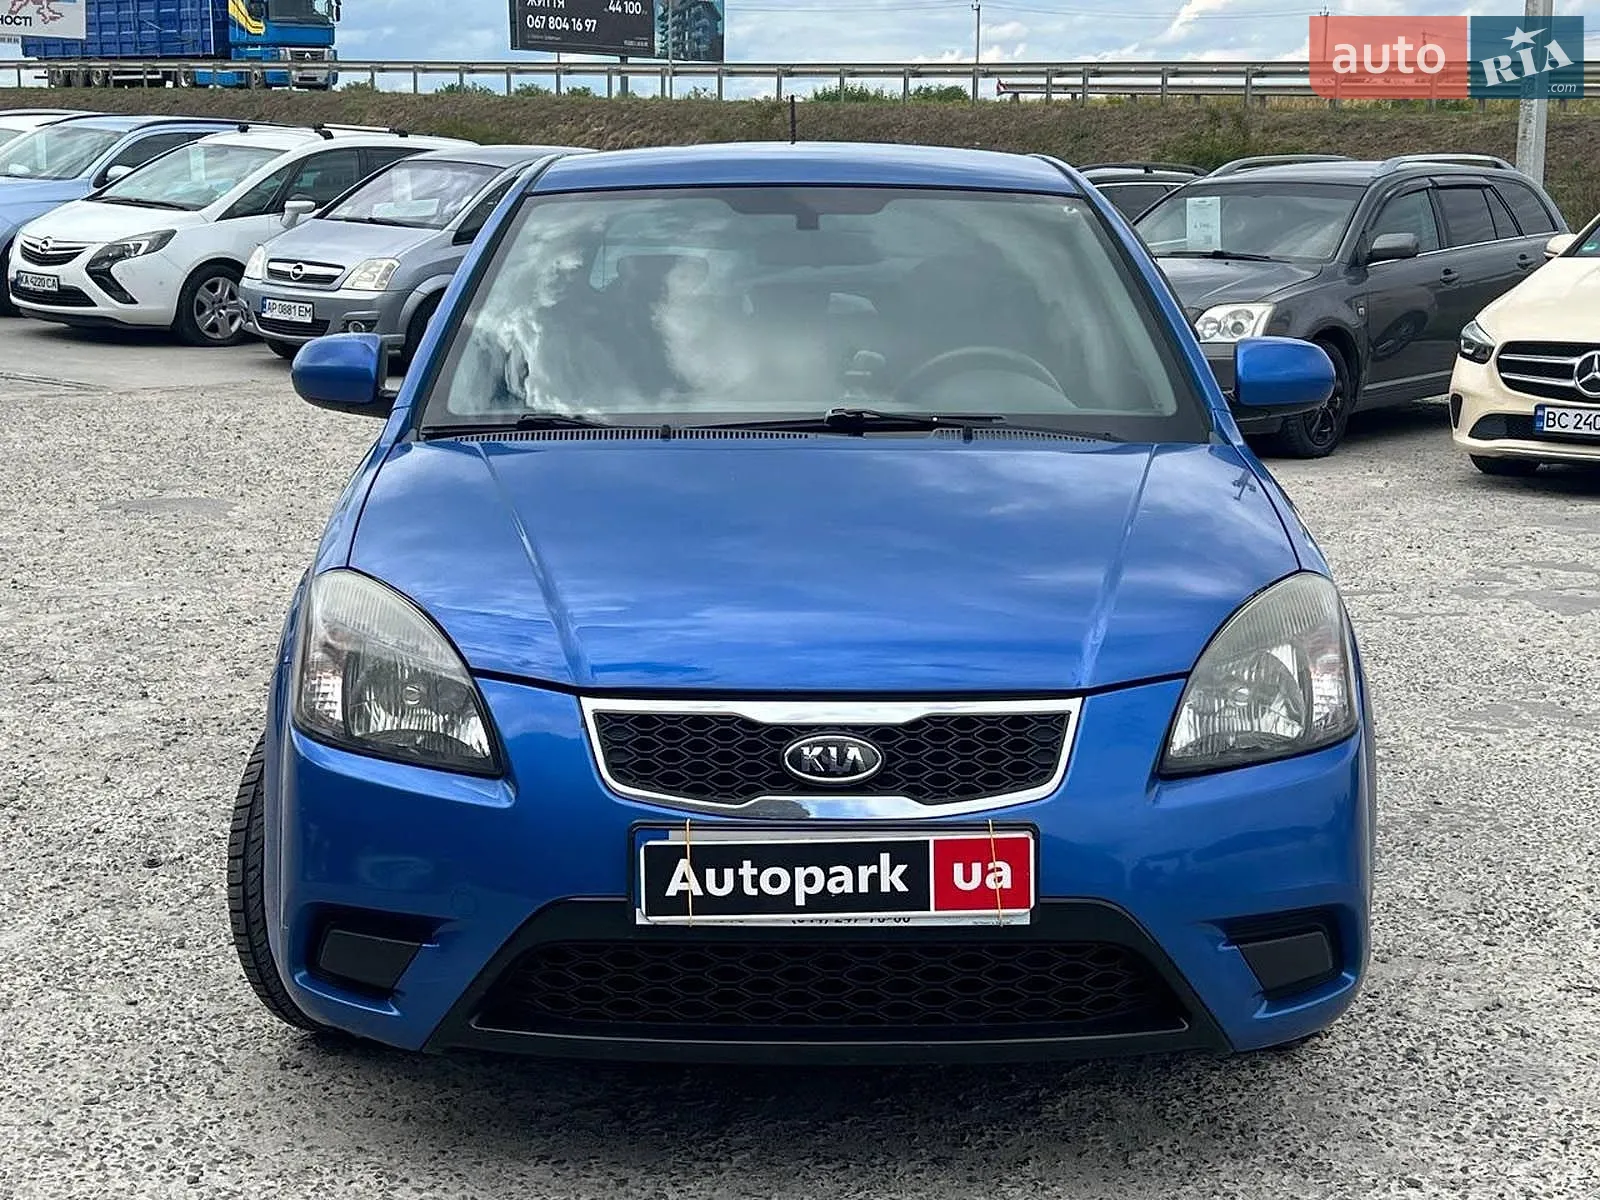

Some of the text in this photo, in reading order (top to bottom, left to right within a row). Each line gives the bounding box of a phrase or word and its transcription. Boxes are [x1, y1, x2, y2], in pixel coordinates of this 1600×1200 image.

[609, 0, 622, 13] 44
[624, 1, 642, 15] 100
[527, 15, 597, 32] 067 804 16 97
[298, 305, 312, 318] EM
[1546, 411, 1569, 428] BC
[800, 746, 866, 772] KIA
[665, 852, 1013, 907] Autopark ua
